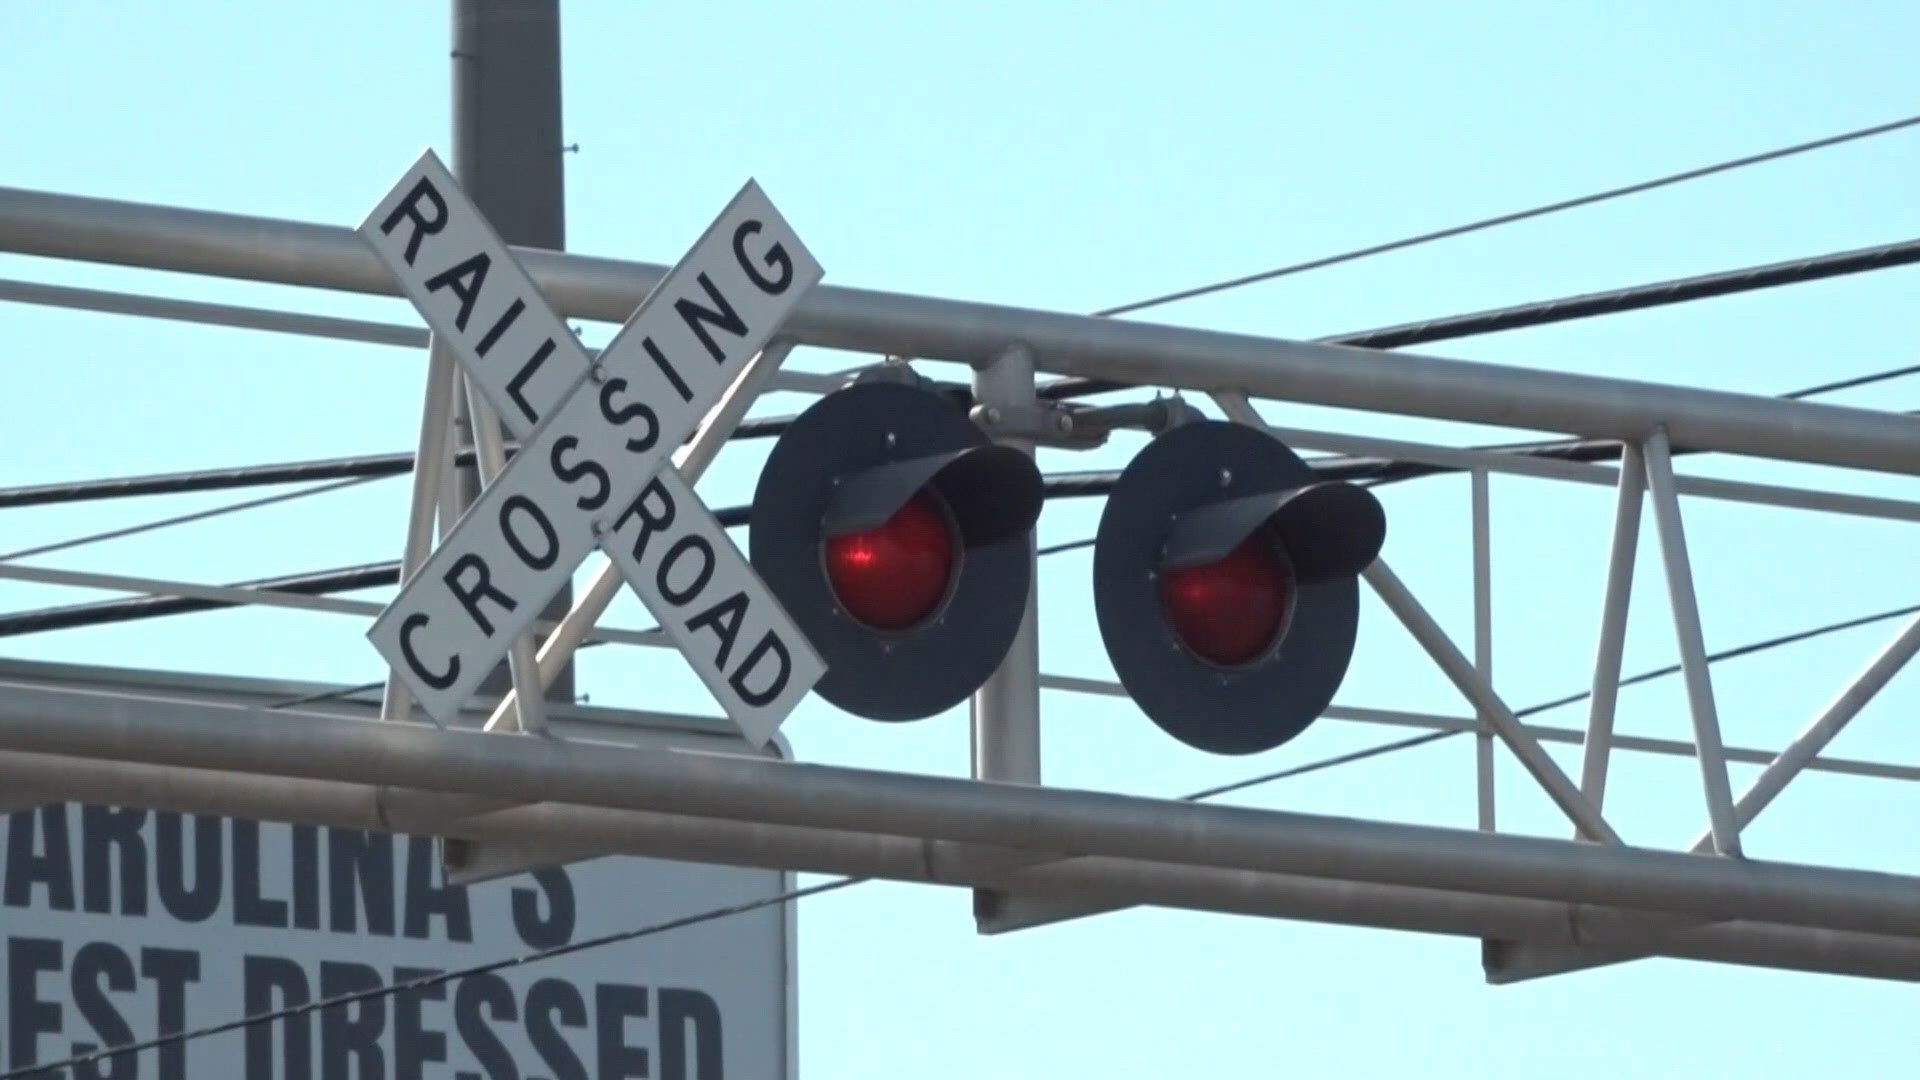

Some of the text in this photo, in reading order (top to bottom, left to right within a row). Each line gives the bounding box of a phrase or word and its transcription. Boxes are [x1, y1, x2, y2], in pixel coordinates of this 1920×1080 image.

[380, 176, 792, 708] RAIL ROAD
[398, 220, 794, 691] CROSSING
[3, 801, 577, 951] AROLINAS
[243, 954, 724, 1080] DRESSED
